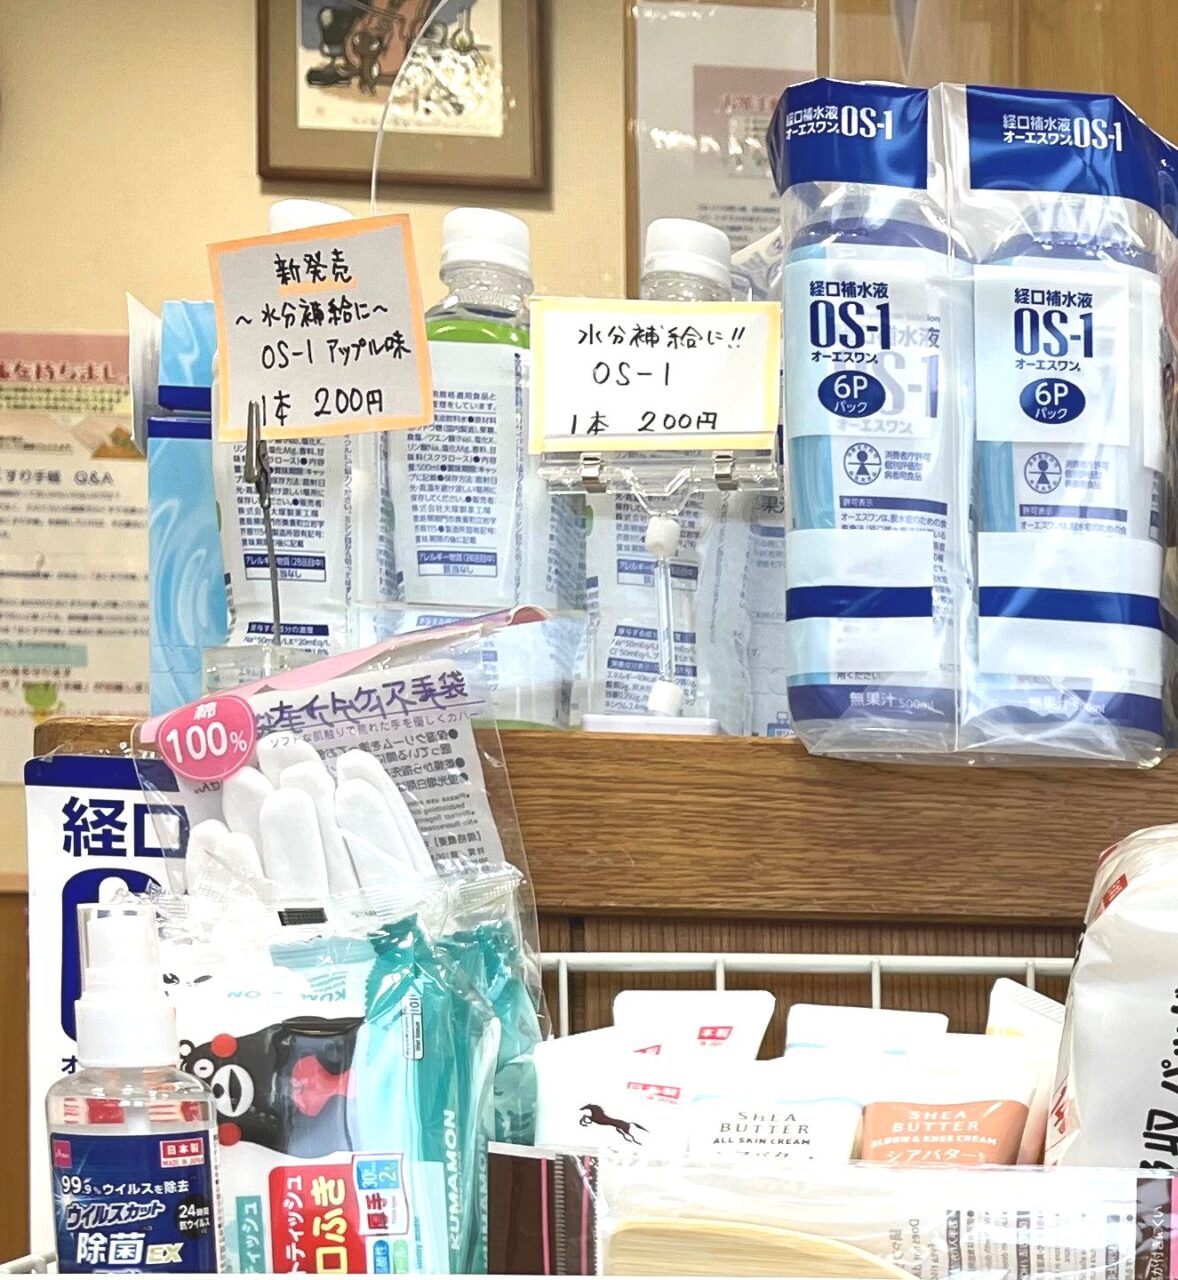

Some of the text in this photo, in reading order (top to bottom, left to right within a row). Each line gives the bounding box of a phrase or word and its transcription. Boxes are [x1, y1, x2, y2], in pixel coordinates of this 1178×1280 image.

[786, 105, 838, 128] 経口補水液
[841, 106, 894, 140] OS-1
[1002, 114, 1072, 132] 経口補水液
[1074, 117, 1123, 151] OS-1
[274, 249, 353, 286] 新発売
[809, 300, 891, 349] OS-1
[1014, 307, 1094, 358] OS-1
[262, 330, 411, 369] OS-1 アップル味
[593, 363, 669, 386] OS-1
[833, 375, 868, 399] 6P
[1035, 382, 1069, 406] 6P
[315, 387, 383, 416] 200円
[834, 399, 868, 414] パック
[571, 411, 719, 435] 1本 200円
[1035, 408, 1068, 420] パック
[74, 470, 113, 486] Q&A
[850, 692, 894, 708] 無果汁
[165, 720, 248, 764] 100%
[63, 796, 191, 858] 経口
[892, 1119, 981, 1134] BUTTER
[908, 1109, 968, 1121] SHEA
[720, 1122, 810, 1136] BUTTER
[167, 1143, 200, 1155] 日本製
[443, 1109, 461, 1251] KUMAMON
[66, 1200, 166, 1230] ウイルスカット
